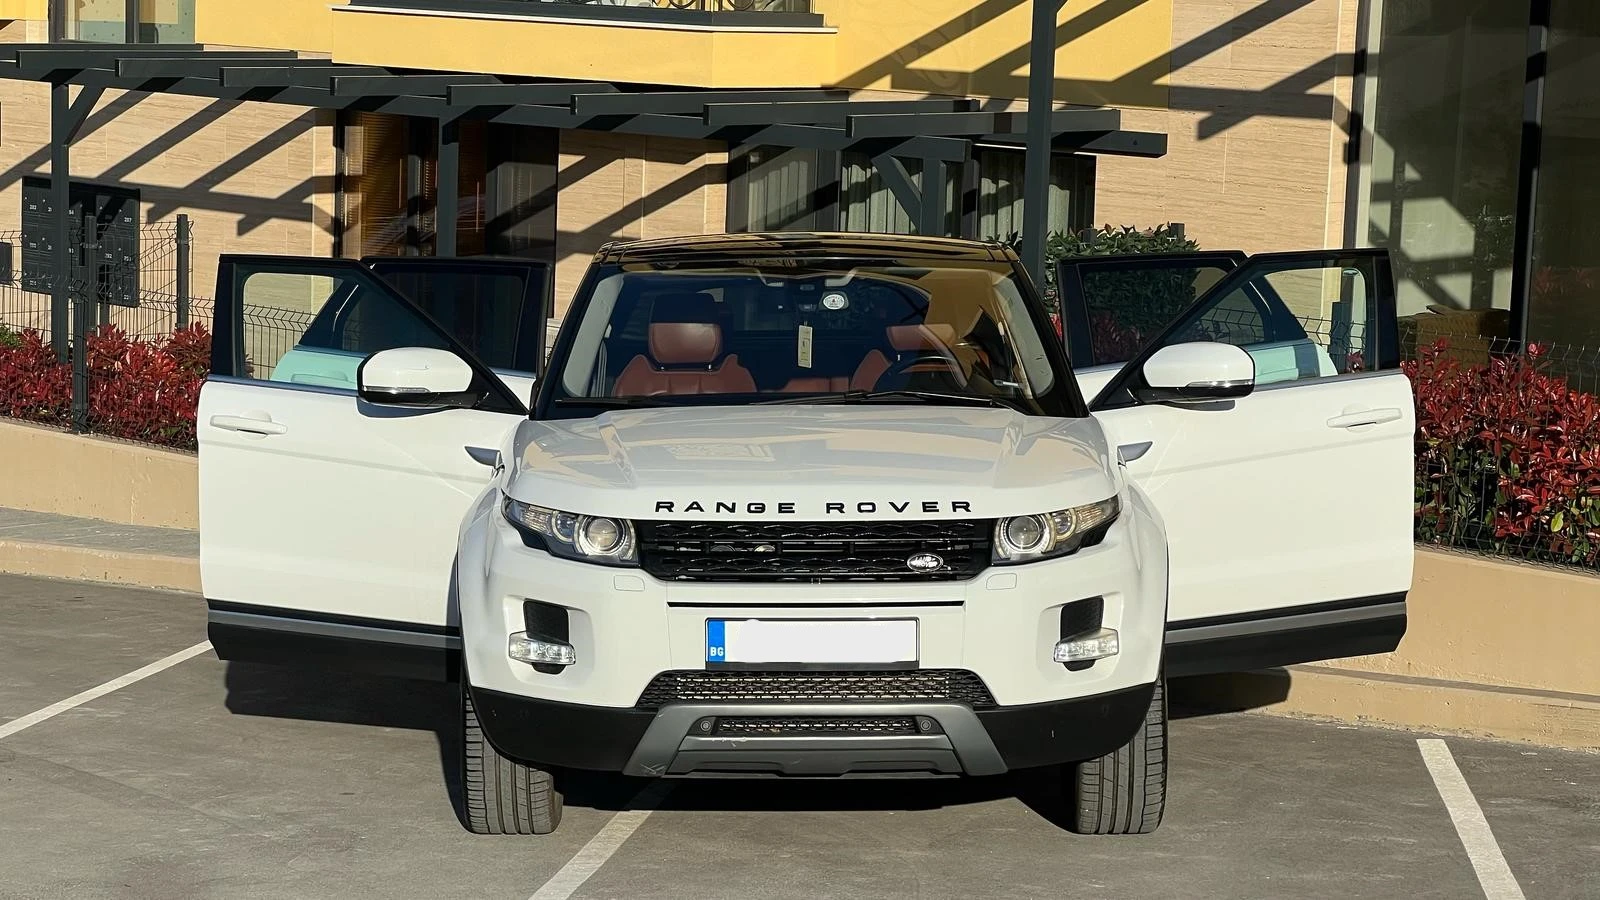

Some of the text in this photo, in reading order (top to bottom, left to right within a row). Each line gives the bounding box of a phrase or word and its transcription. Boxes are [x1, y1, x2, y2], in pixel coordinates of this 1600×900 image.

[655, 501, 972, 514] RANGE ROVER
[710, 646, 724, 657] BG
